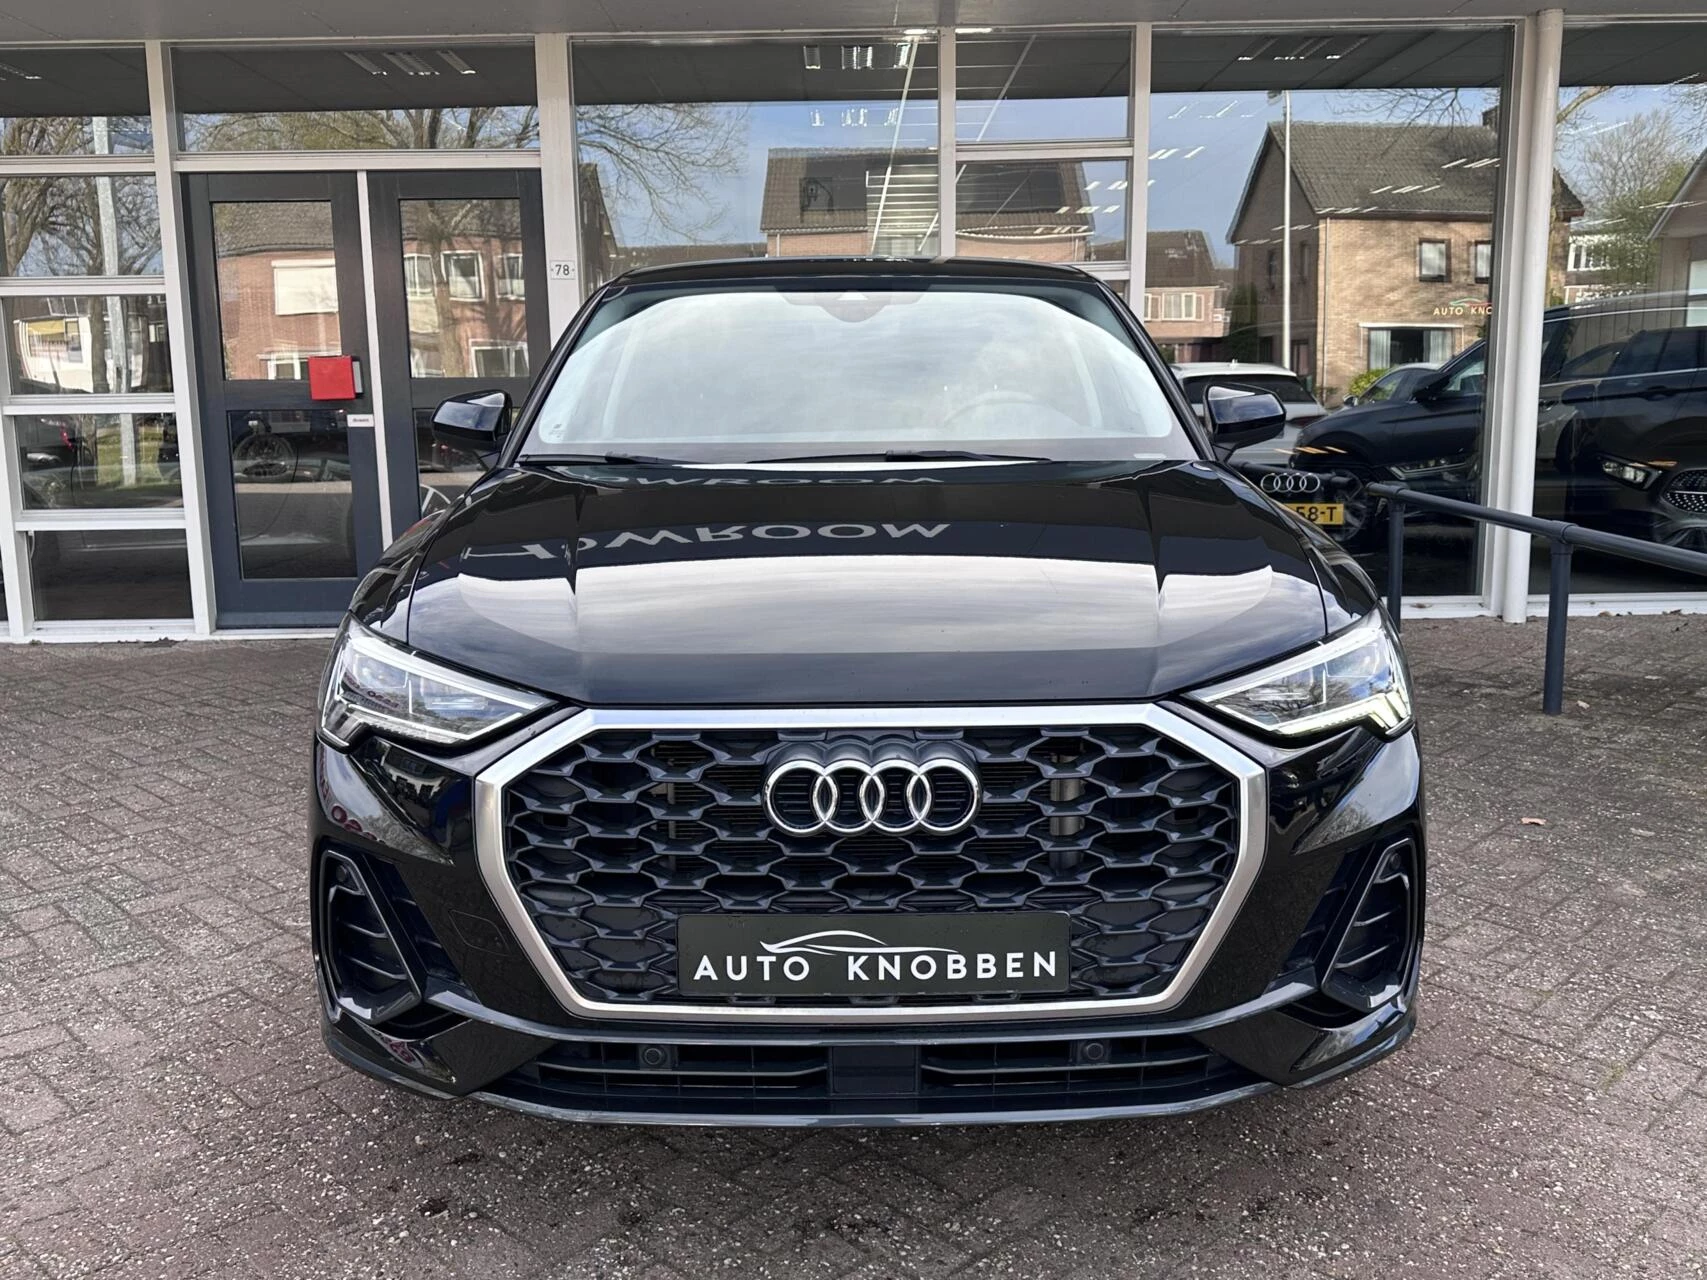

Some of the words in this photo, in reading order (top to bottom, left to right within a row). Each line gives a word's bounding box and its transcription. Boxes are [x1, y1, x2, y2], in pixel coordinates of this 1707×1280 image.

[555, 264, 570, 276] 78
[1433, 307, 1464, 316] AUTO
[693, 954, 810, 982] AUTO
[847, 951, 1056, 982] KNOBBEN
